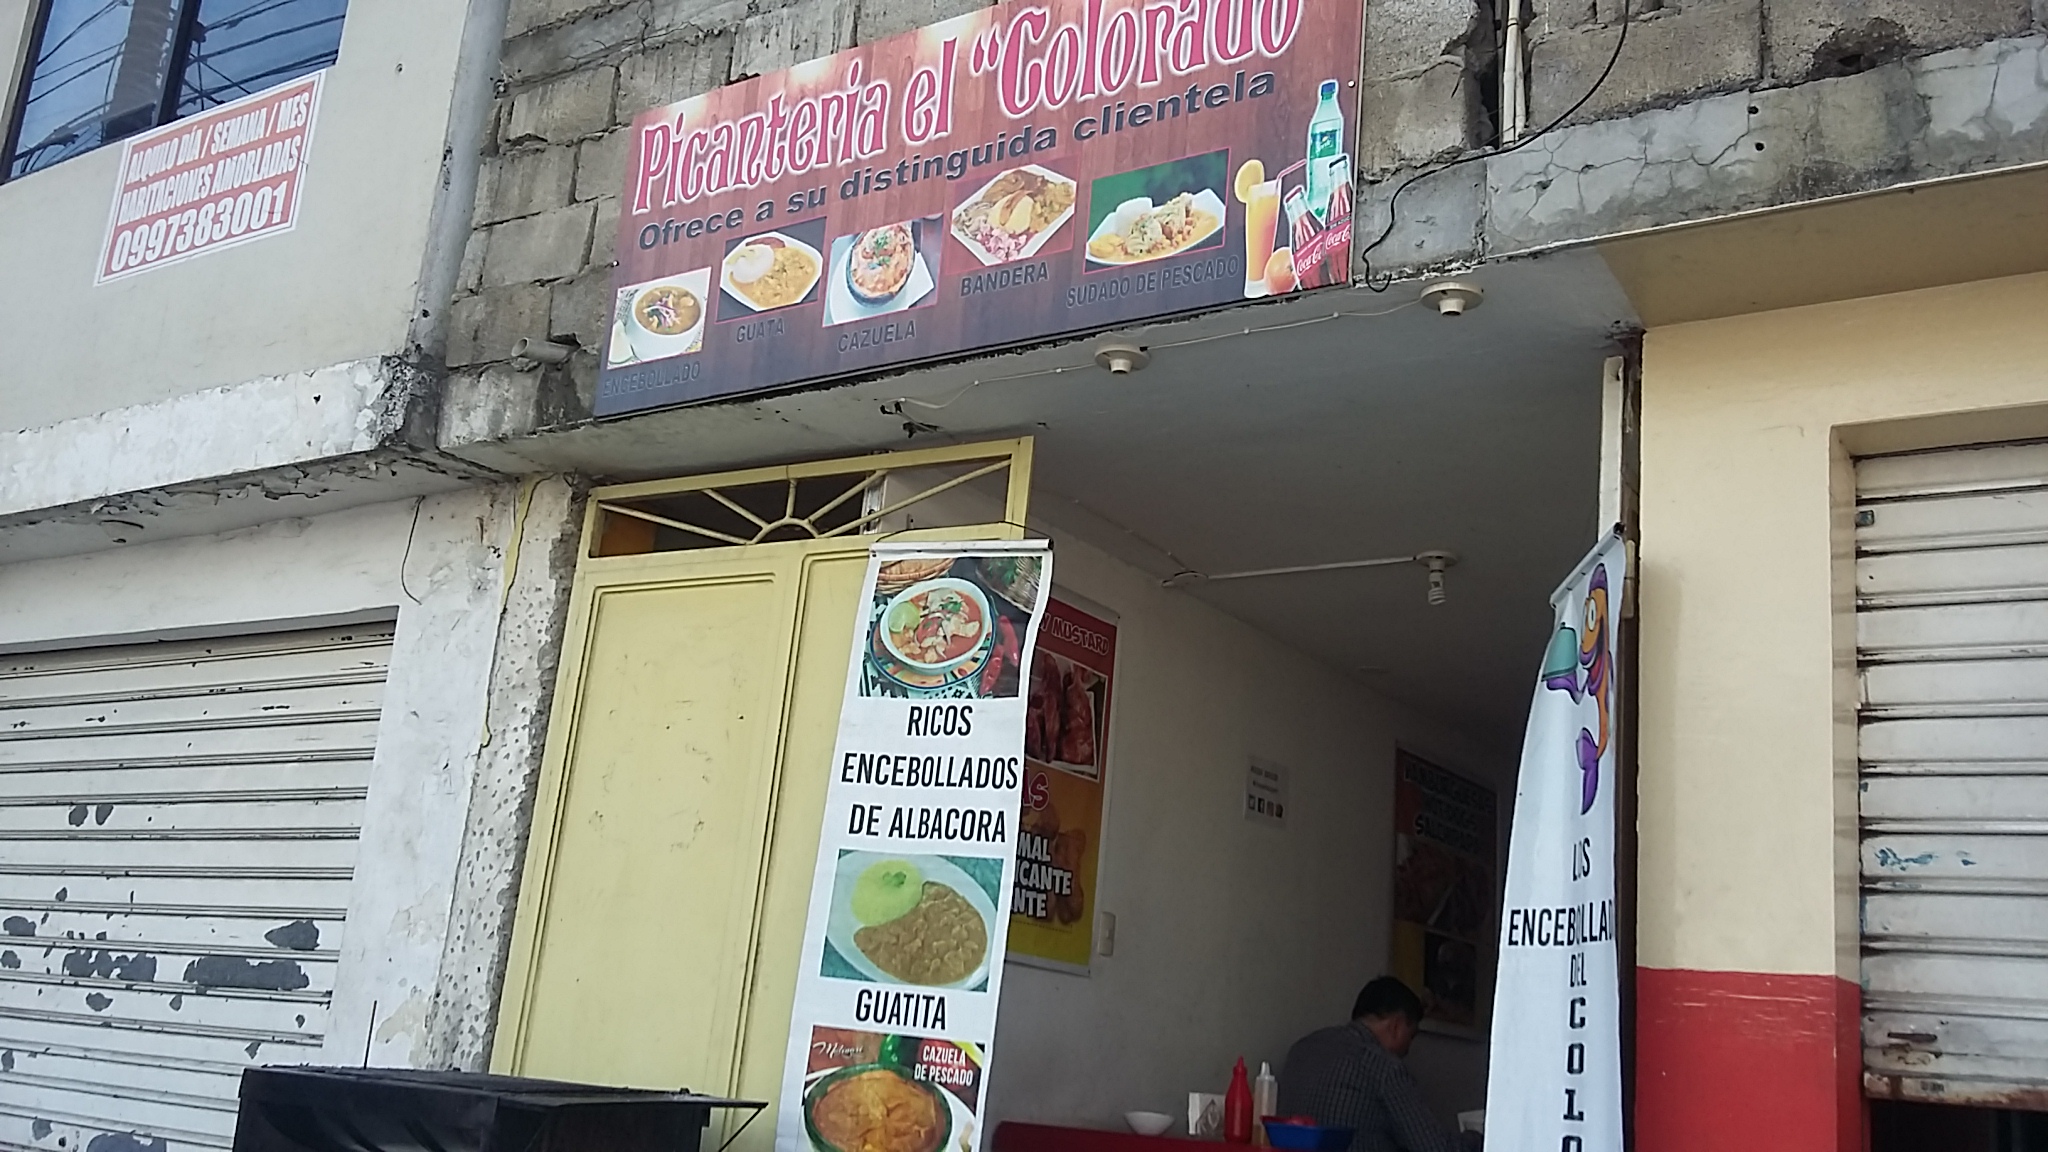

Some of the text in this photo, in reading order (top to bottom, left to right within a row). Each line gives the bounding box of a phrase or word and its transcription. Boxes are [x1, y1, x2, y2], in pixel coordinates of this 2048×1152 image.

[211, 108, 268, 155] SEMANA
[276, 92, 310, 133] MES
[634, 59, 888, 213] Picanteria
[905, 37, 957, 142] el
[639, 70, 1275, 250] Ofrece a su distinguida clientela
[117, 134, 301, 226] HABITACIONES AMOBLADAS
[111, 181, 288, 272] 0997383001
[960, 261, 1049, 297] BANDERA
[1066, 254, 1240, 309] SUDADO DE PESCADO
[736, 317, 786, 344] GUATA
[837, 320, 917, 354] CAZUELA
[601, 360, 701, 399] ENCEBOLLADO
[907, 705, 973, 736] RICOS
[841, 752, 1019, 789] ENCEBOLLADOS
[849, 804, 1006, 843] DE ALBACORA
[855, 988, 948, 1031] GUATITA
[914, 1062, 974, 1087] DE PESCADO
[923, 1045, 966, 1067] CAZUELA
